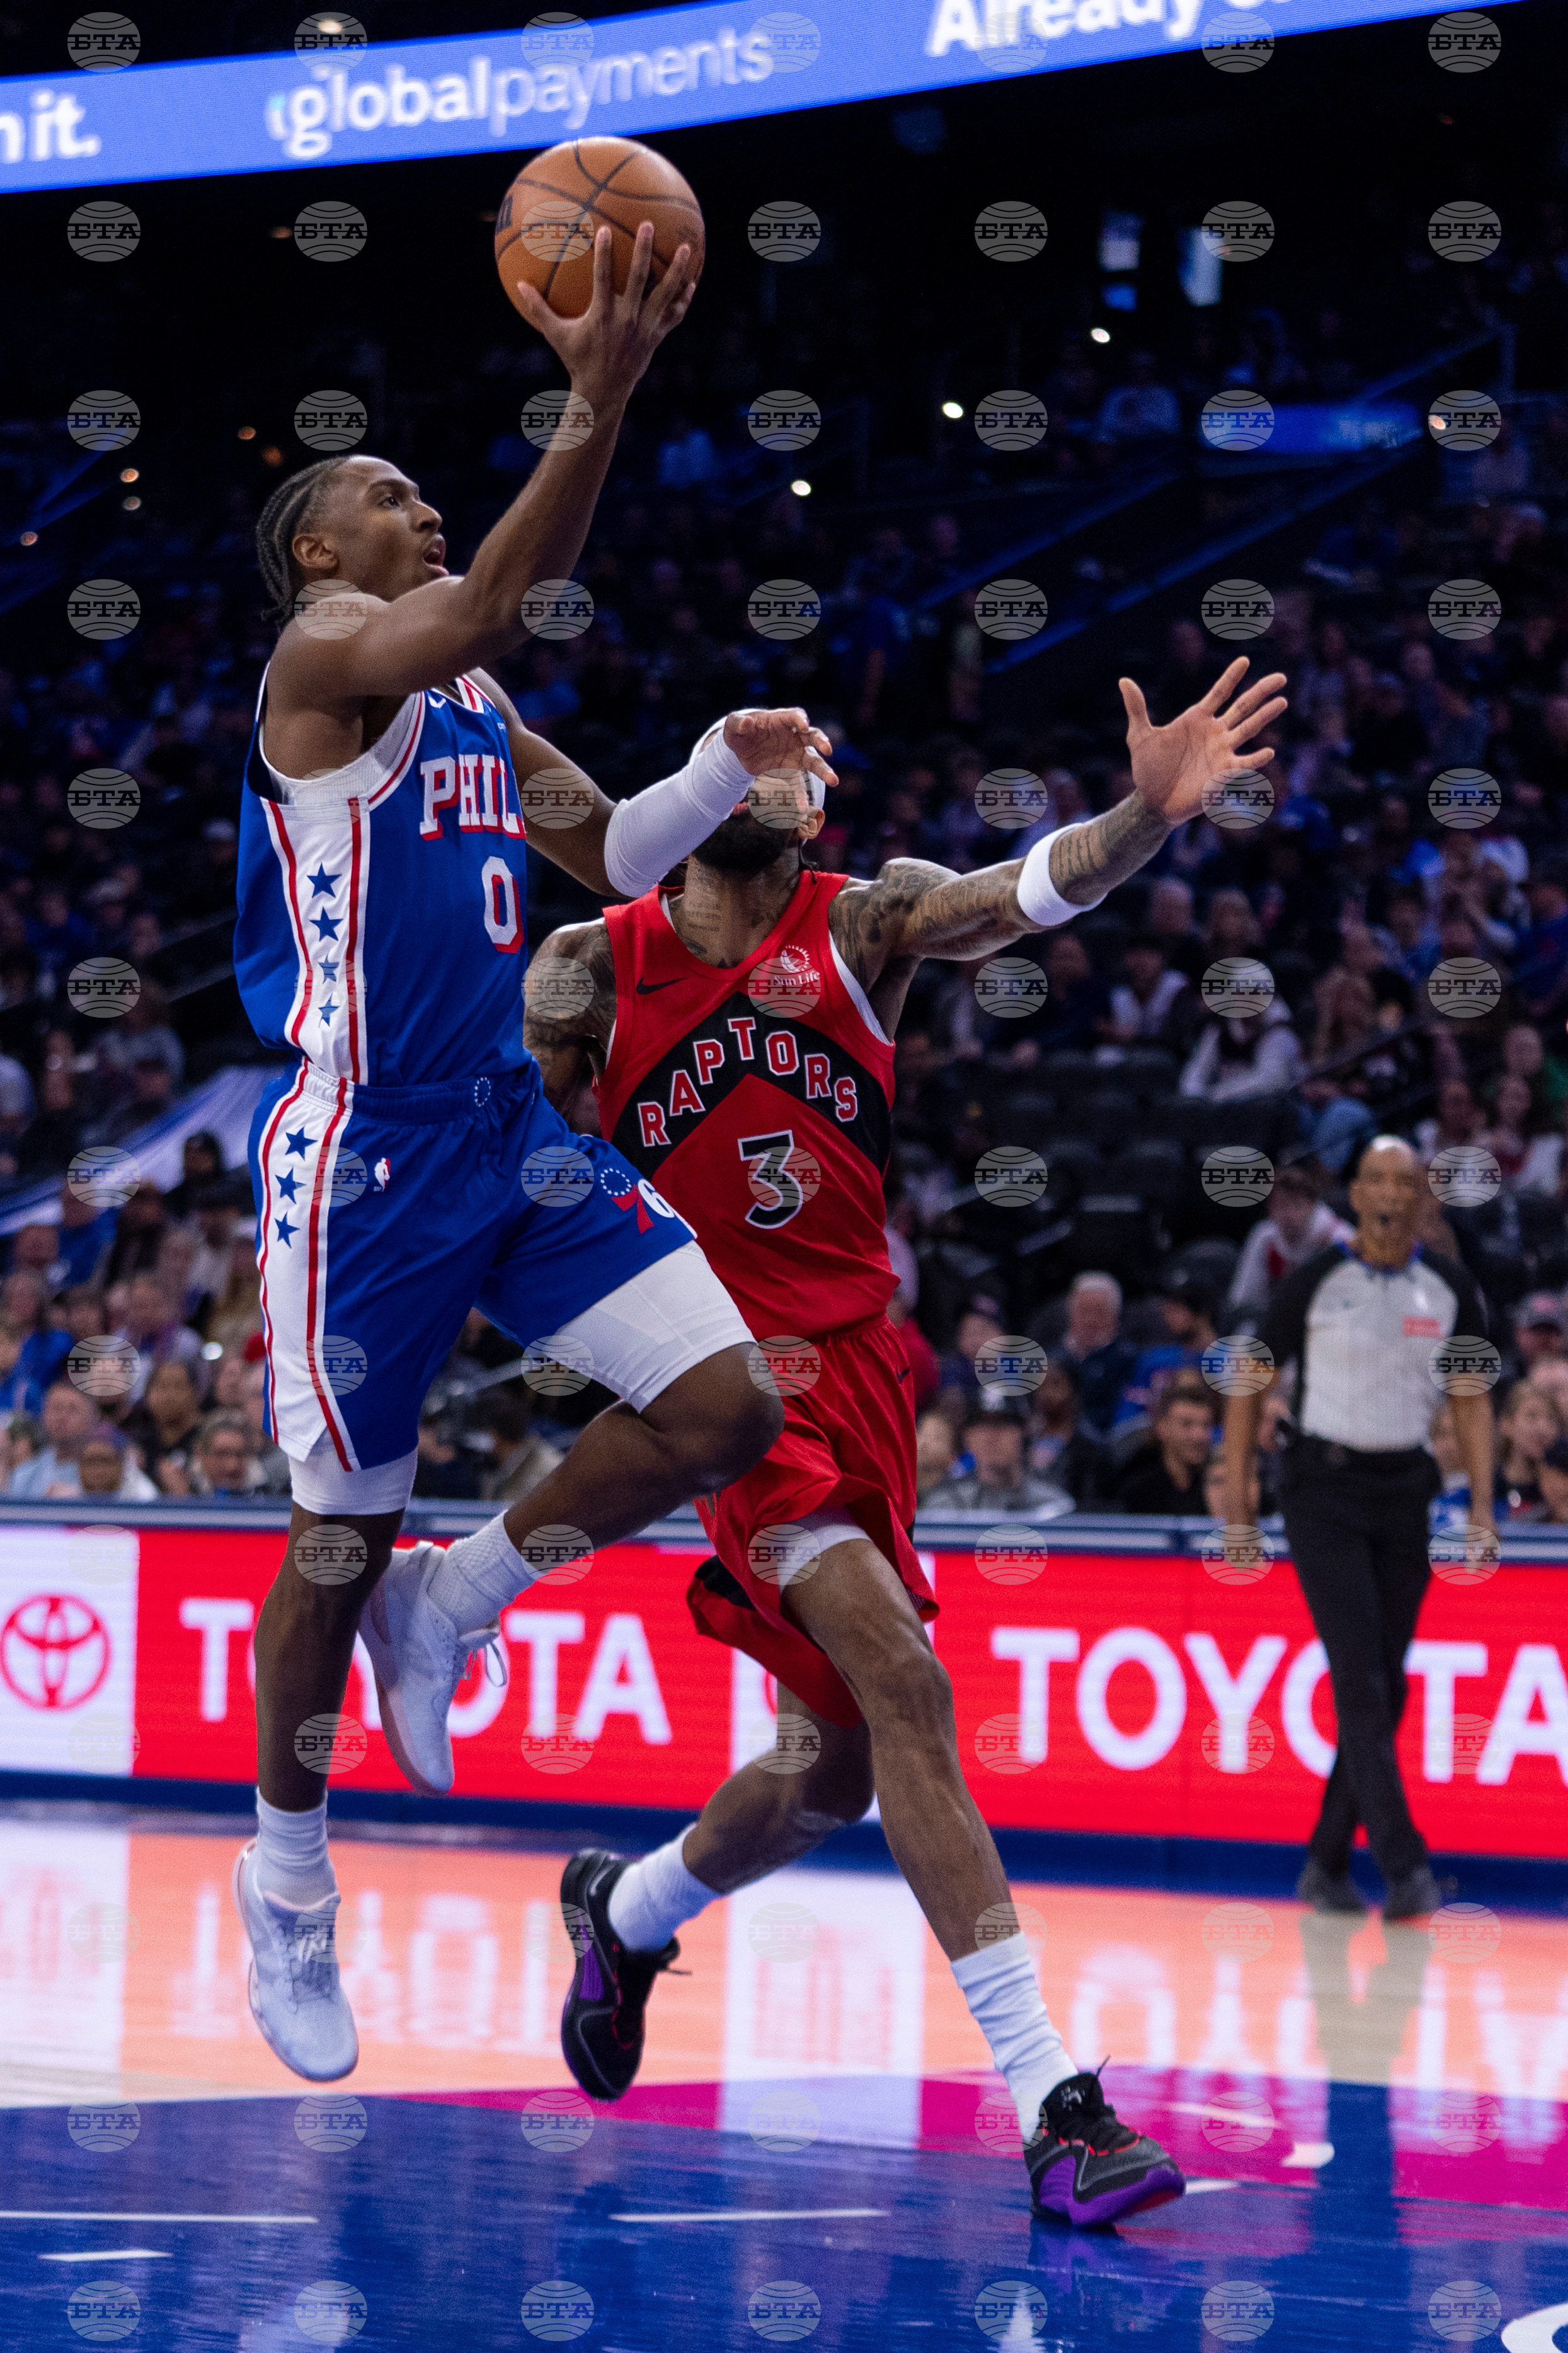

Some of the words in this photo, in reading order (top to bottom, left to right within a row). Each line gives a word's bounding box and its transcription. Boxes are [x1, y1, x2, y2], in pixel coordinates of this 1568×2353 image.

[283, 26, 775, 159] globalpayments
[481, 856, 525, 953] 0
[774, 974, 797, 987] Sun
[797, 970, 821, 985] Life
[638, 1016, 859, 1147] RAPTORS
[737, 1129, 804, 1229] 3
[178, 1594, 673, 1747] TTA
